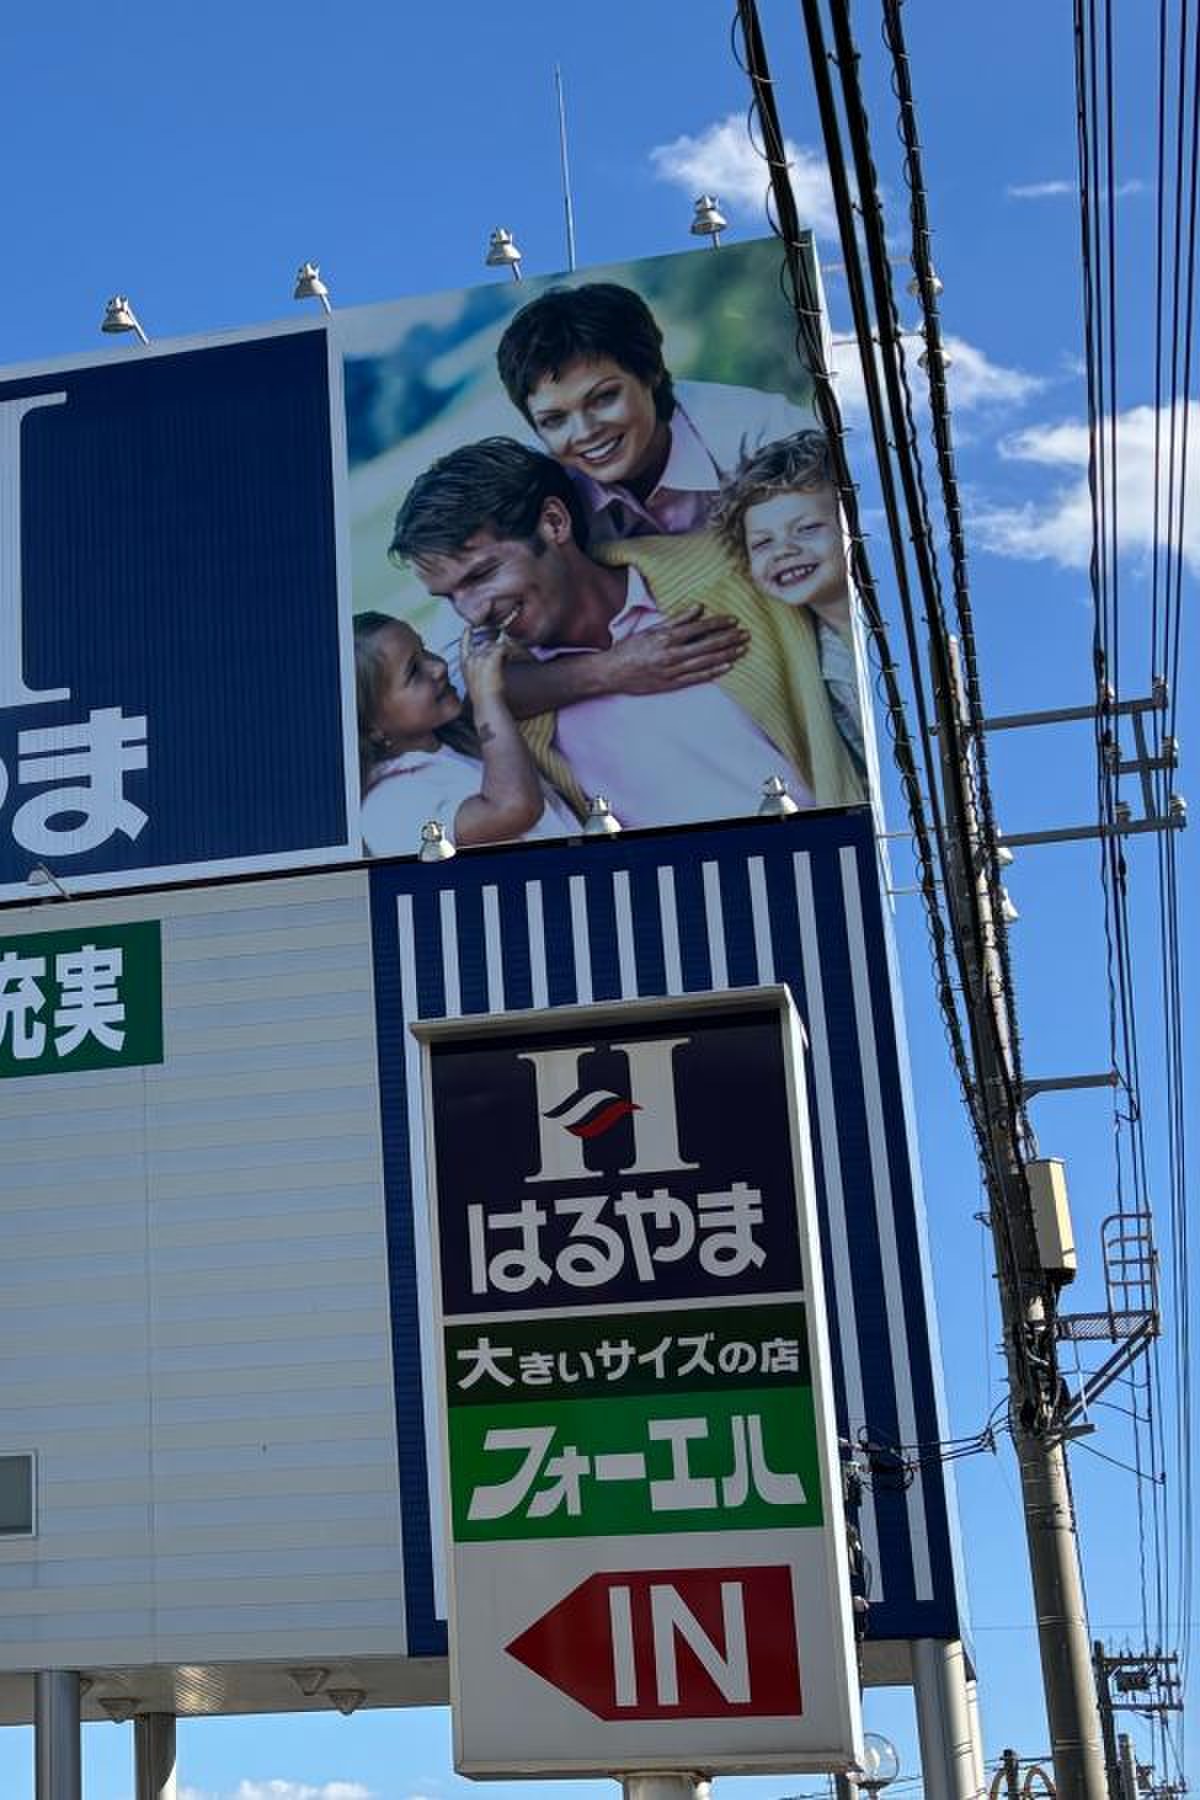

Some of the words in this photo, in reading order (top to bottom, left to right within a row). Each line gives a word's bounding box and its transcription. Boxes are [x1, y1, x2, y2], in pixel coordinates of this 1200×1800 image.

[467, 1182, 766, 1295] はるやま
[456, 1335, 800, 1391] 大きいサイズの店
[466, 1414, 807, 1521] フォーエル
[608, 1581, 752, 1708] IN
